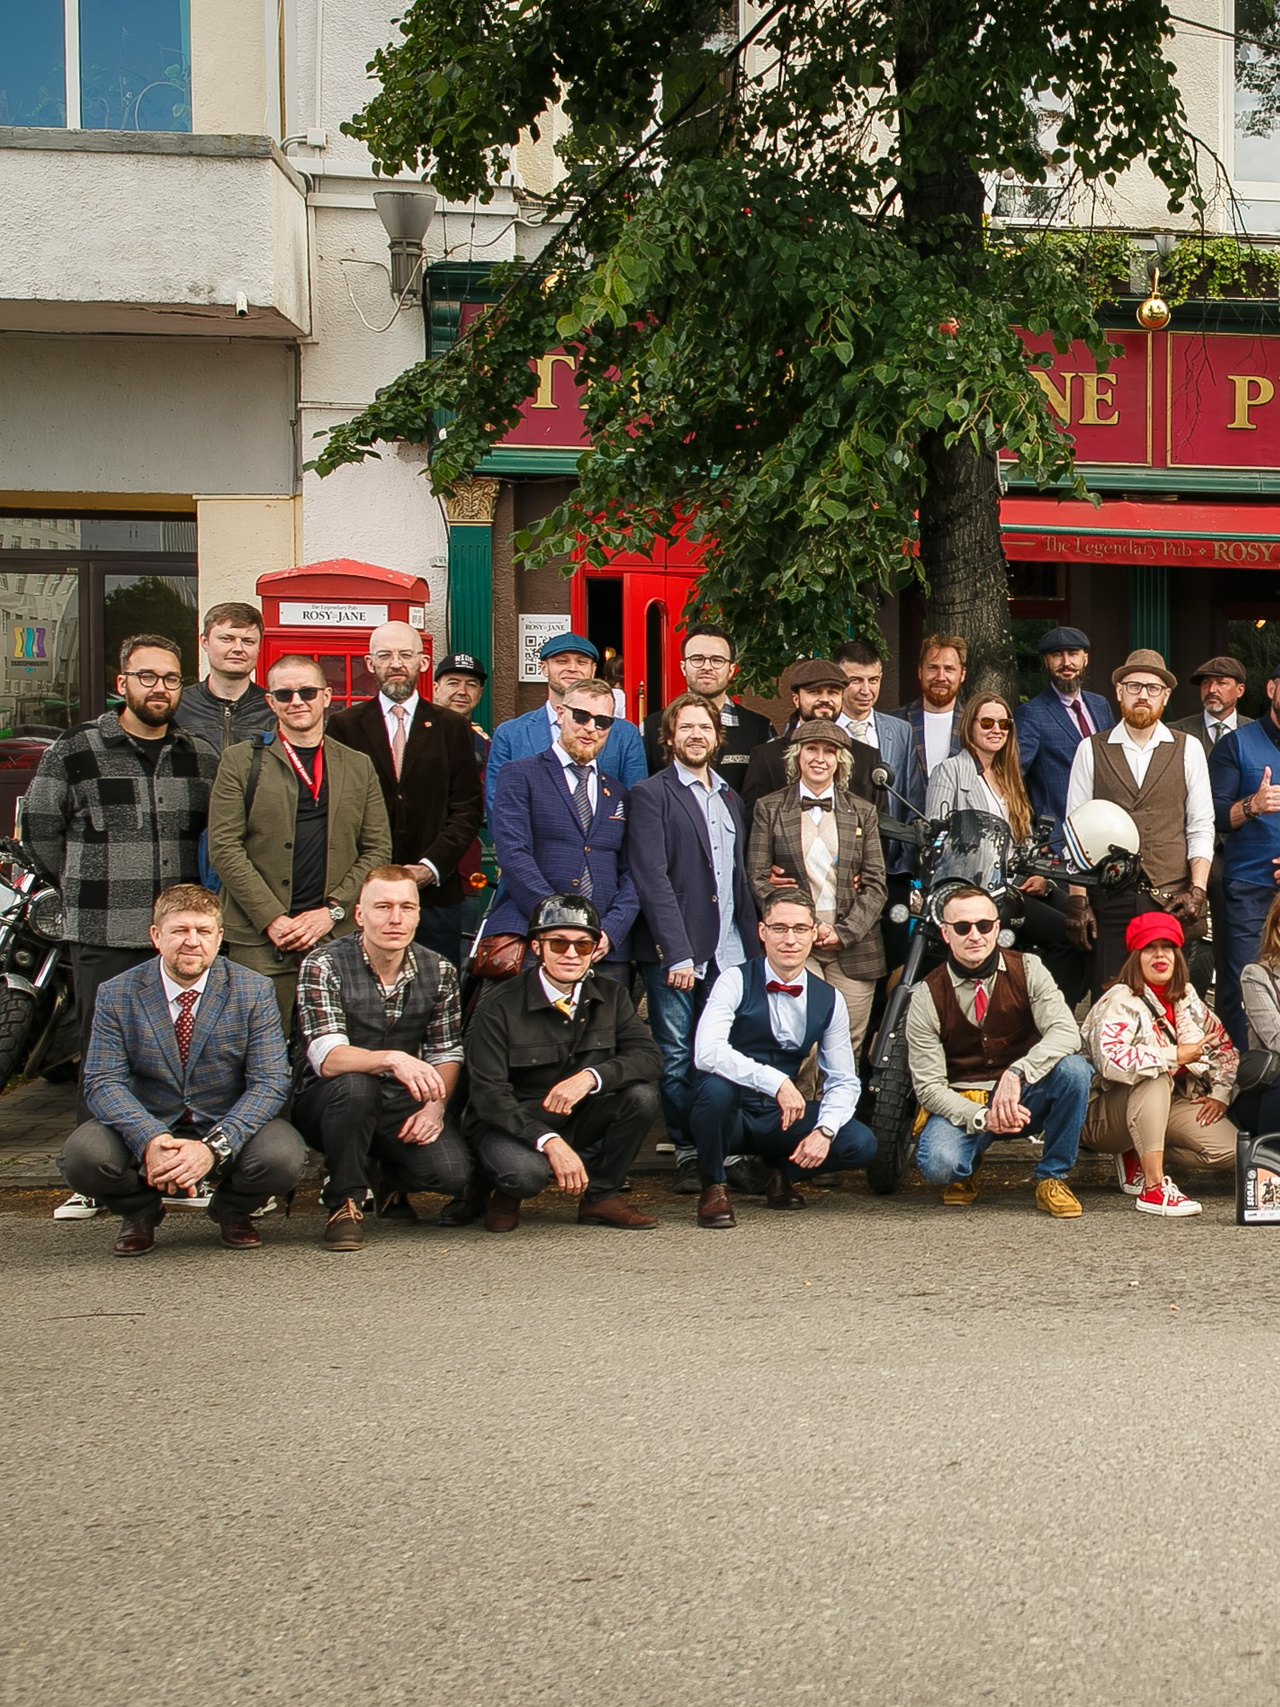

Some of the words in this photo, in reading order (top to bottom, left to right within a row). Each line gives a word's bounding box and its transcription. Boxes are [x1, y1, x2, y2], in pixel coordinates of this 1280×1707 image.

[1042, 535, 1072, 553] The
[1074, 538, 1158, 560] Legendary
[1162, 540, 1193, 557] Pub
[1212, 541, 1276, 562] ROSY
[302, 610, 333, 620] ROSY
[336, 611, 367, 623] JANE
[547, 624, 566, 632] JANE
